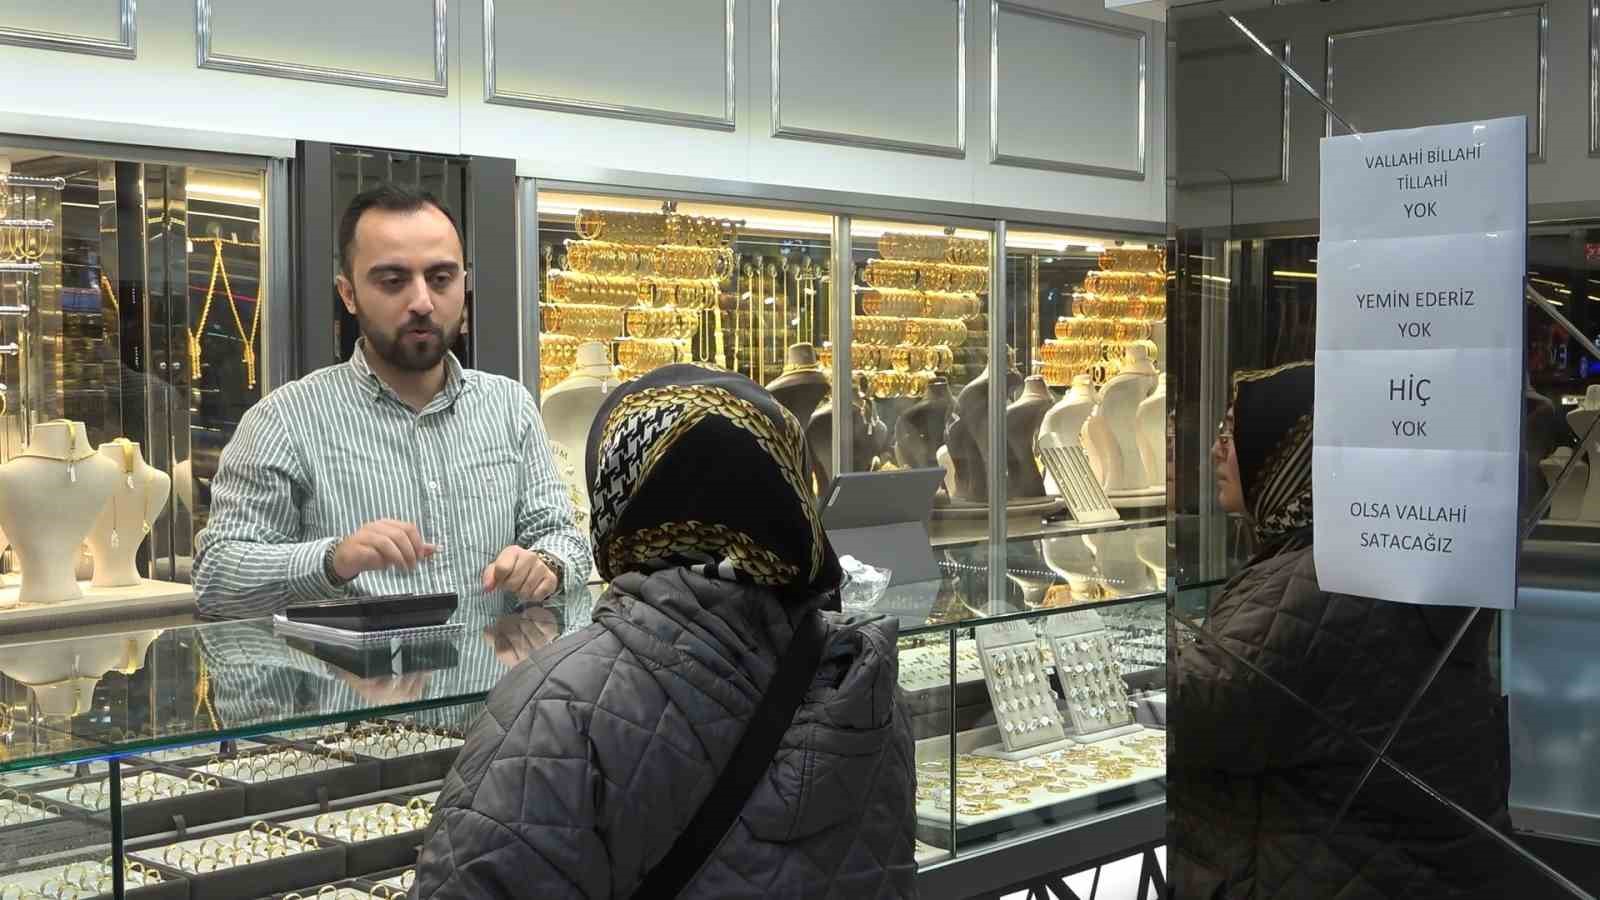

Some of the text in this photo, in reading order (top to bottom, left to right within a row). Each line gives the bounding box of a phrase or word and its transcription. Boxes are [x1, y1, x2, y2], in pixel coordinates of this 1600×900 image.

[1397, 171, 1448, 190] TİLLAHİ
[1403, 201, 1438, 219] YOK
[1356, 288, 1475, 309] YEMİN EDERİZ
[1397, 322, 1433, 338] YOK
[1389, 374, 1432, 406] HİÇ
[1391, 420, 1427, 437] YOK
[1350, 502, 1467, 524] OLSA VALLAHİ
[1360, 532, 1453, 554] SATACAĞIZ
